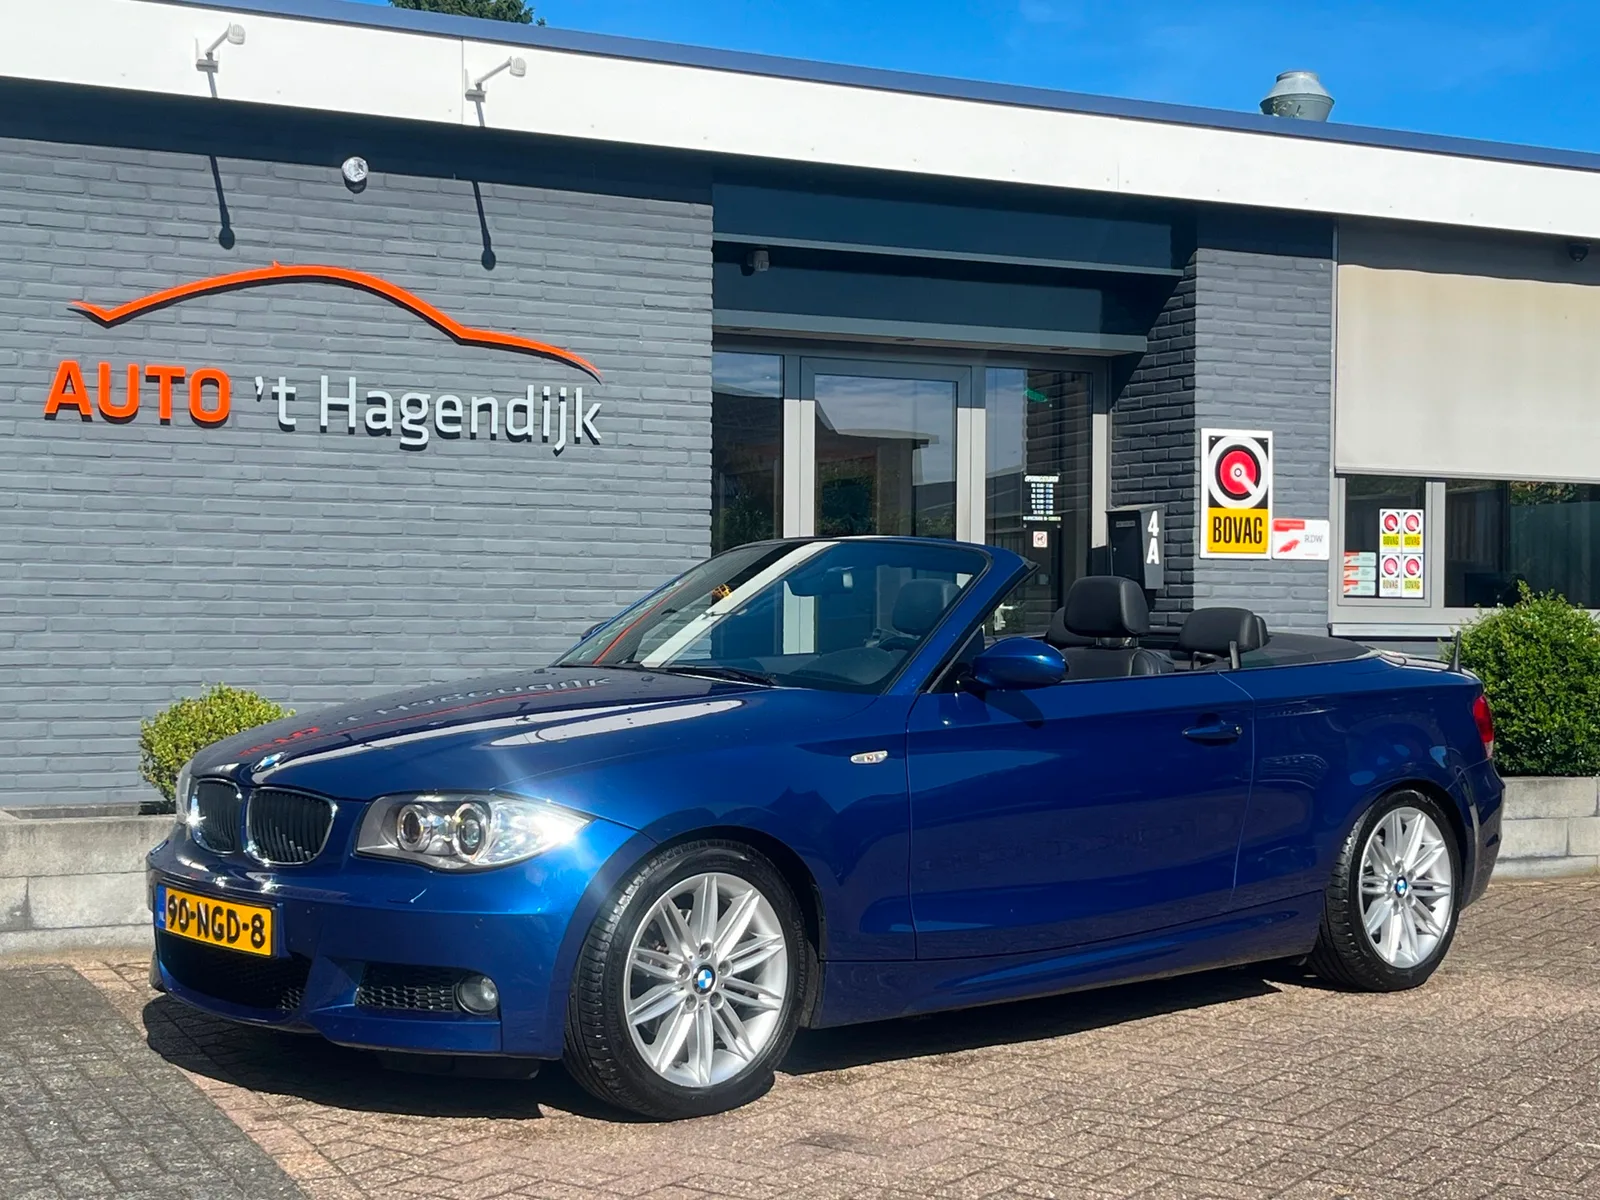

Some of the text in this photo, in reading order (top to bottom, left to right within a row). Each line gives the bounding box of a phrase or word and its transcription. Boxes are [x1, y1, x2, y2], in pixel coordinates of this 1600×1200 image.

[44, 360, 231, 424] AUTO
[320, 375, 602, 453] Hagendijk
[1213, 516, 1263, 545] BOVAG
[1304, 534, 1324, 544] RDW
[167, 893, 266, 949] 90-NGD-8
